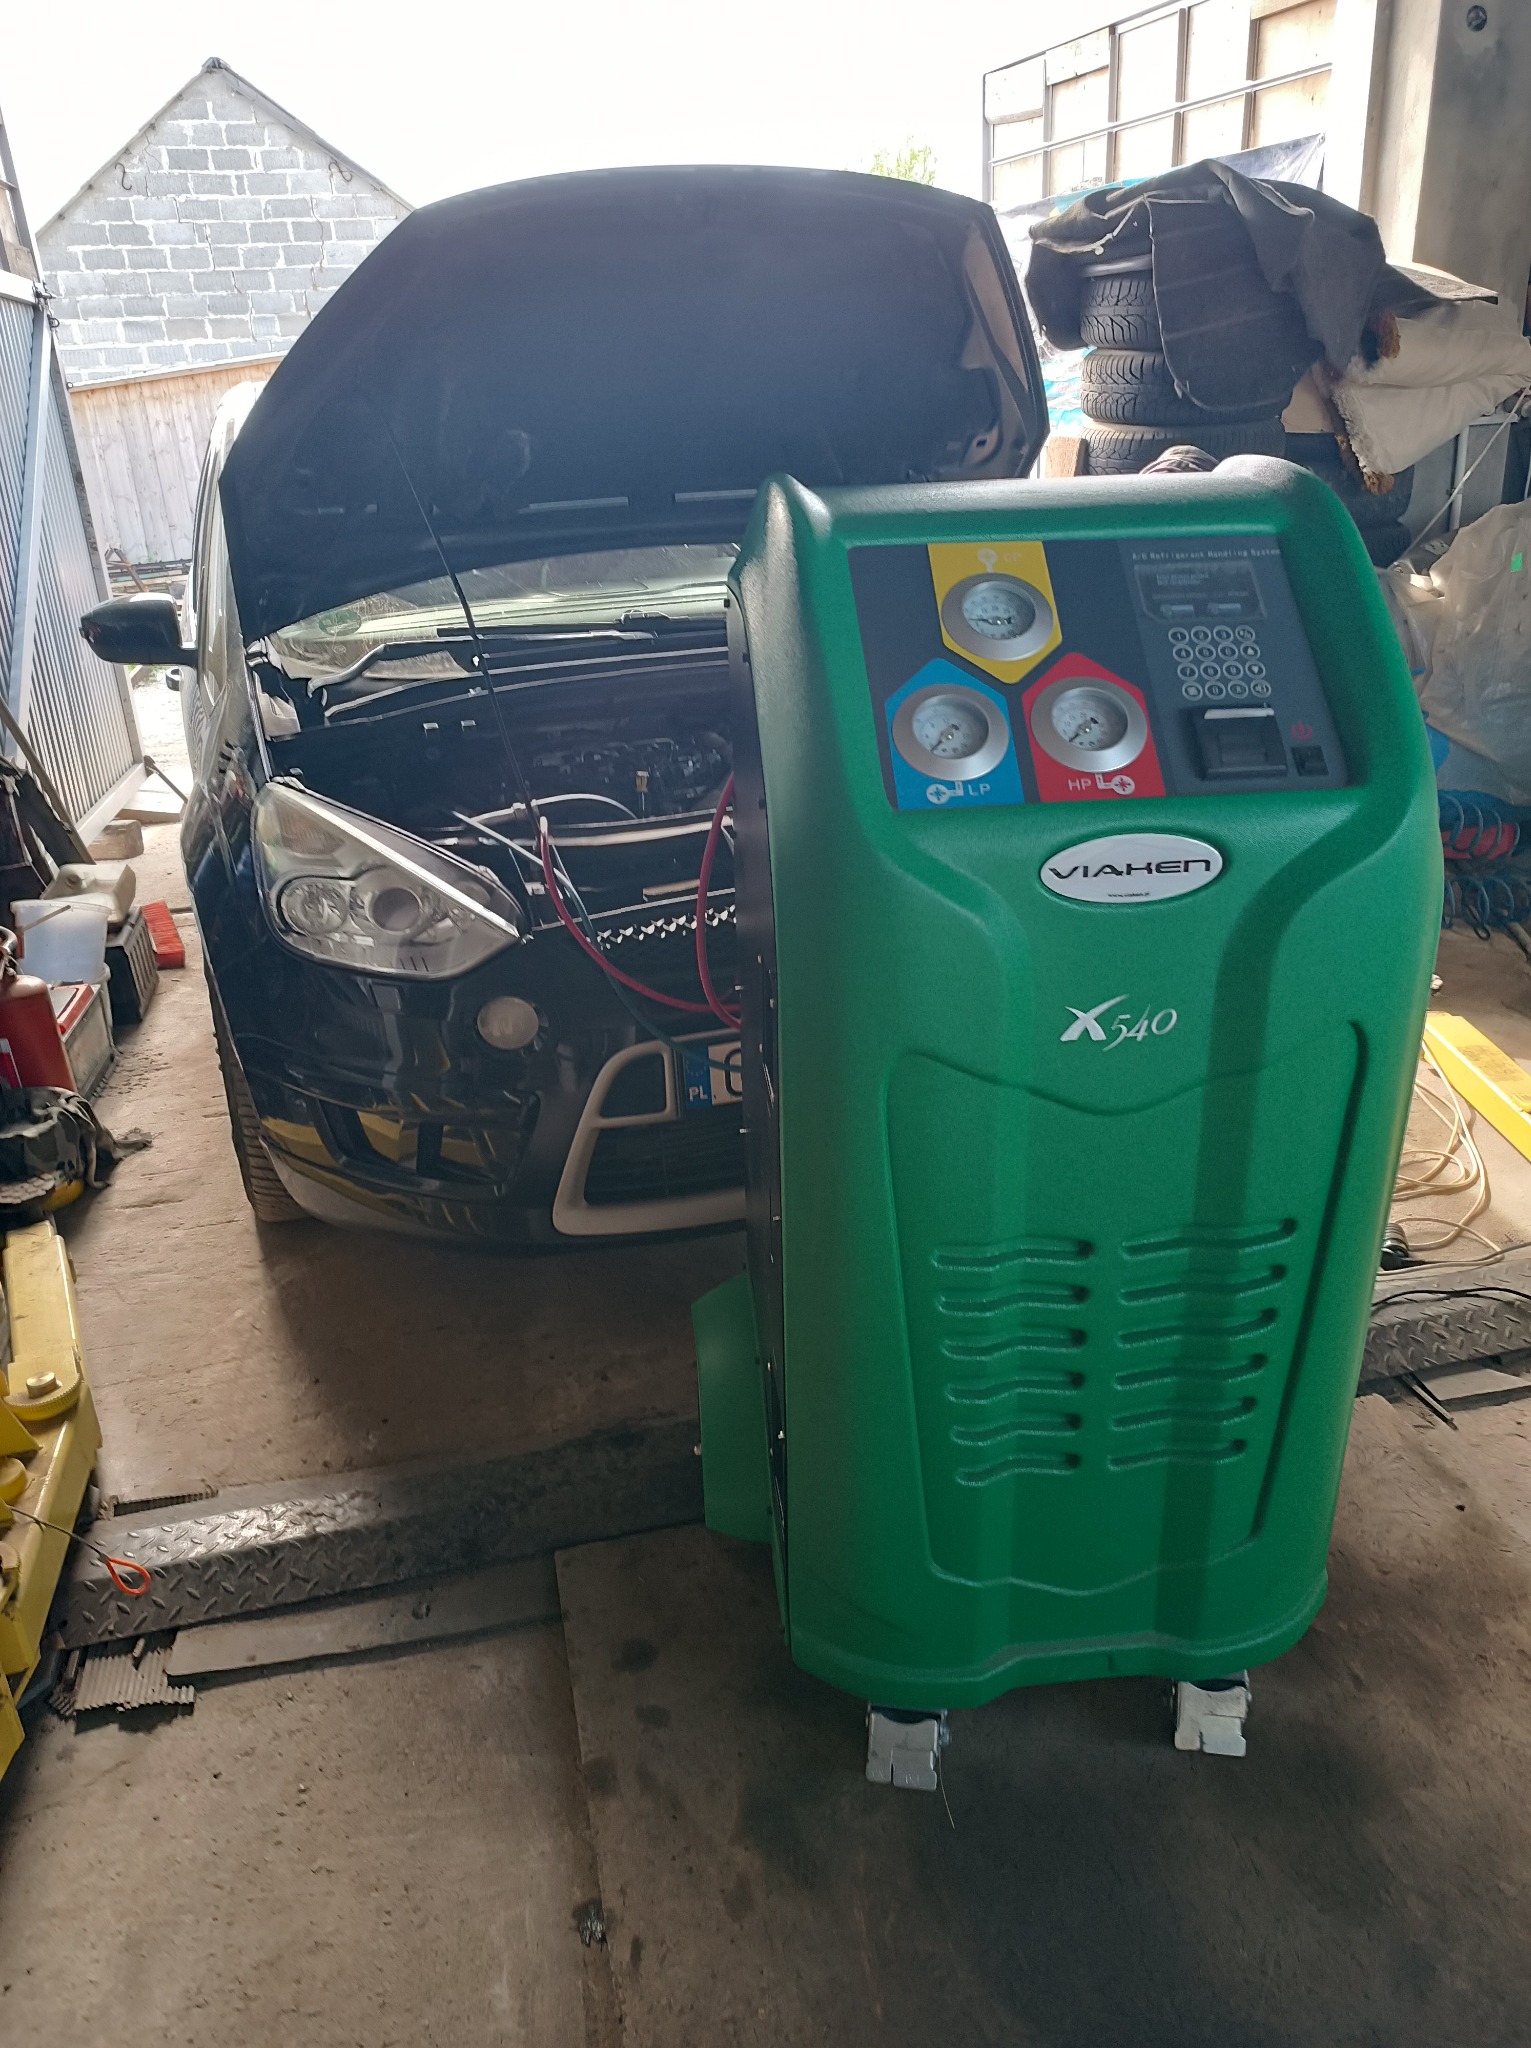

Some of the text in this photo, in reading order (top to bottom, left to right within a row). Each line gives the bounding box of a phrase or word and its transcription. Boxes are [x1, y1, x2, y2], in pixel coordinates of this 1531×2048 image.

[1207, 549, 1248, 559] Handling
[968, 783, 991, 797] LP
[1068, 778, 1092, 791] HP
[1048, 858, 1212, 880] VIAKEN
[1059, 993, 1178, 1052] X540
[688, 1085, 709, 1103] PL
